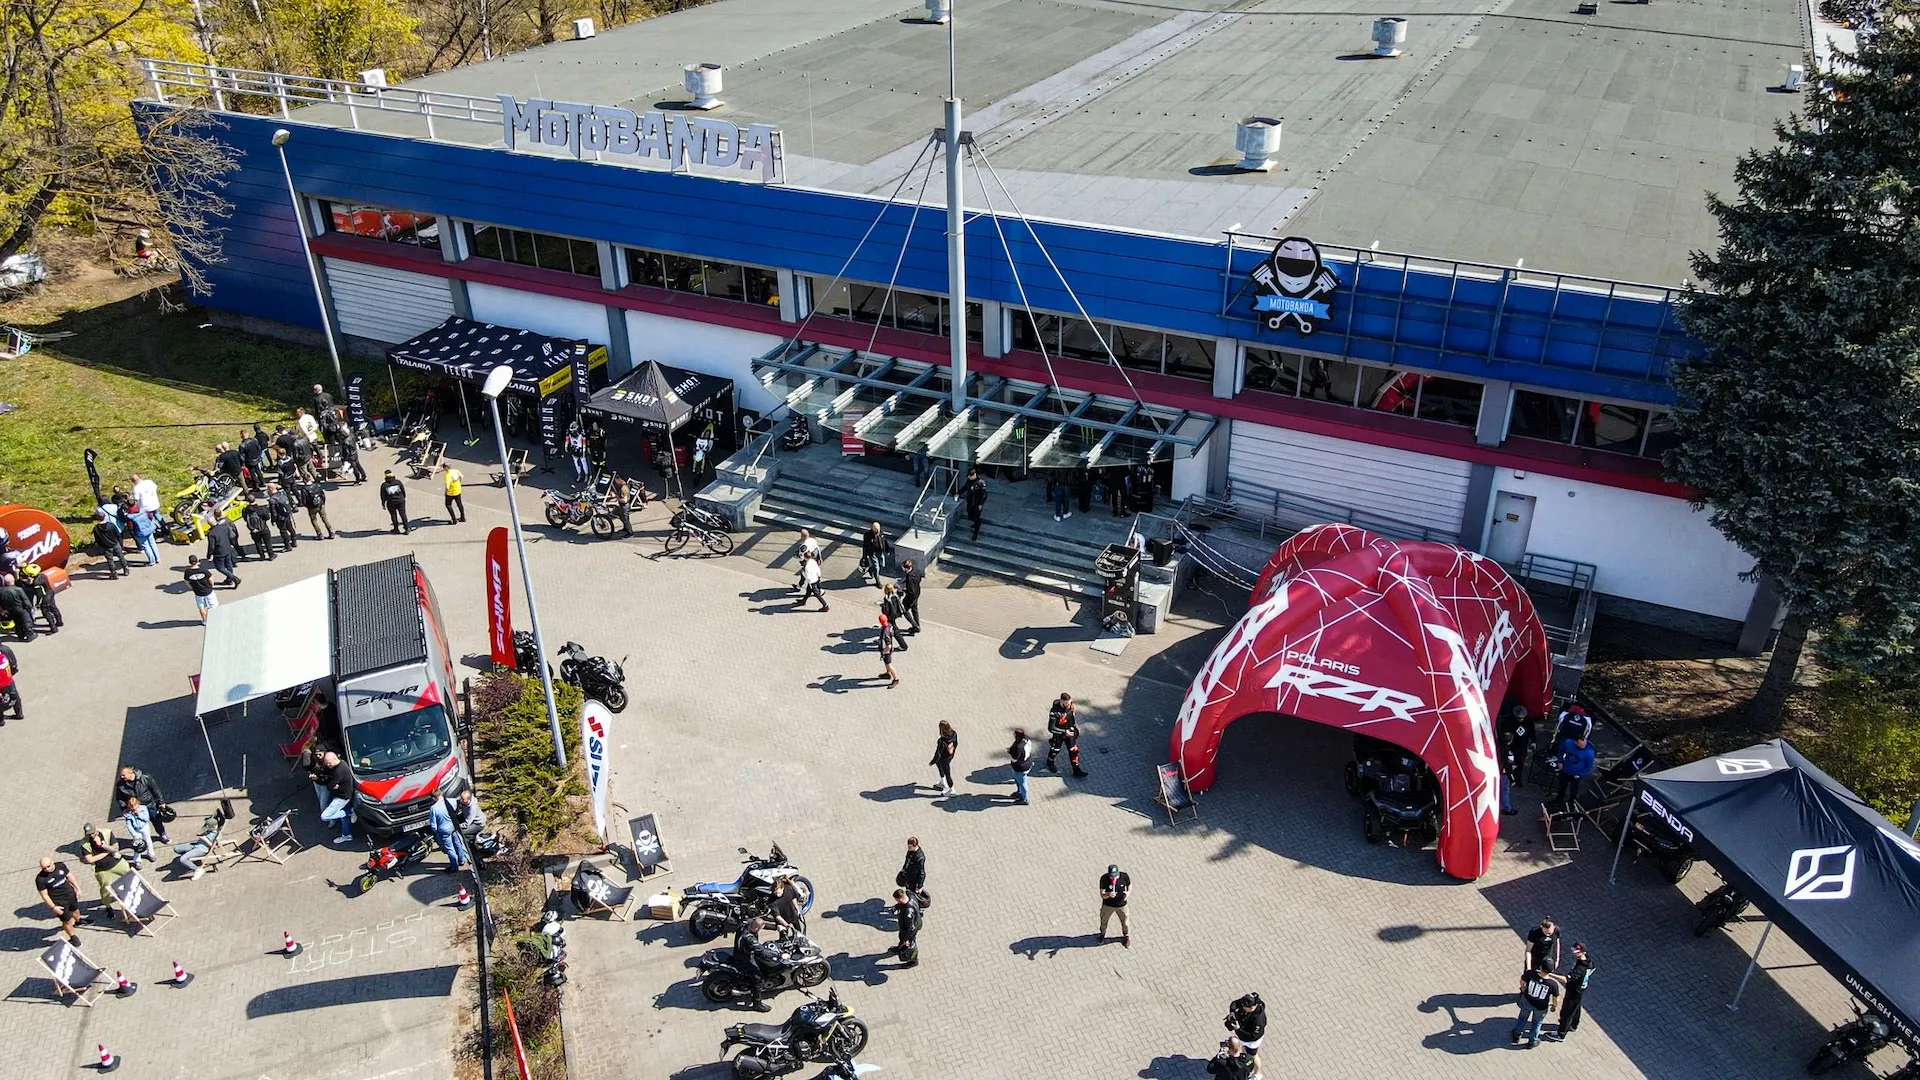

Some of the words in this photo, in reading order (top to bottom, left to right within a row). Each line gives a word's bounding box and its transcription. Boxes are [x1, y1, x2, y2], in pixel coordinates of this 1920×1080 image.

[1269, 298, 1314, 313] MOTOBANDA
[506, 382, 536, 393] LARIA
[576, 361, 586, 393] SHOT
[674, 376, 698, 395] SHOT
[348, 385, 365, 422] PERUN
[626, 391, 659, 405] SHOT
[1286, 650, 1361, 677] POLARIS
[355, 684, 419, 708] SHIMA
[1263, 663, 1426, 724] RZR
[1641, 790, 1694, 843] BENDA
[1845, 973, 1892, 1019] UNLEASH
[1892, 1015, 1913, 1037] THE
